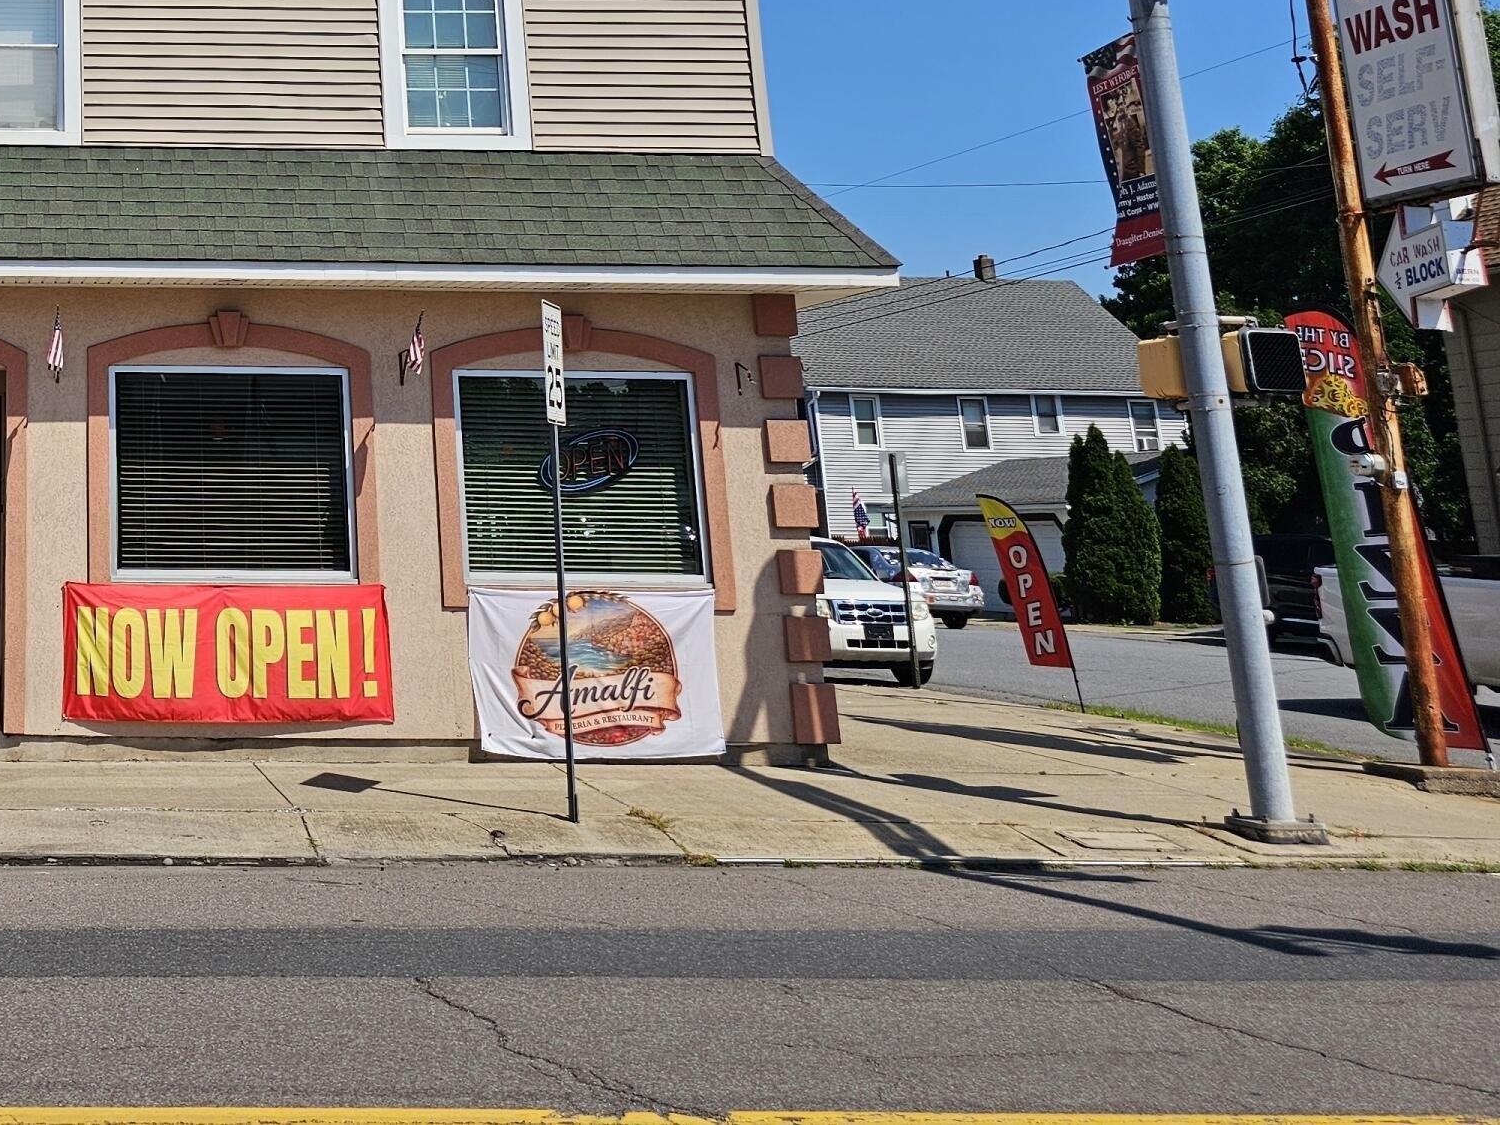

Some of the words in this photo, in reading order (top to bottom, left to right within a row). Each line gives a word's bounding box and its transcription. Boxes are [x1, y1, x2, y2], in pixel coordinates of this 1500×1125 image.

[1092, 80, 1108, 95] LEST
[1118, 64, 1140, 85] FORET
[1365, 95, 1451, 160] SERV
[1397, 164, 1413, 175] TURN
[1412, 160, 1430, 172] HERE
[1117, 198, 1132, 208] rmy
[1115, 232, 1143, 247] Daughter
[1389, 246, 1410, 267] CAR
[1412, 235, 1441, 259] WASH
[1404, 257, 1446, 287] BLOCK
[544, 315, 560, 338] SPEED
[547, 341, 560, 361] LIMIT
[547, 365, 562, 410] 25
[556, 442, 625, 481] OPEN
[1008, 545, 1056, 655] OPEN
[77, 606, 198, 699] NOW
[518, 665, 655, 720] Amalfi
[602, 714, 654, 724] RESTAURANT
